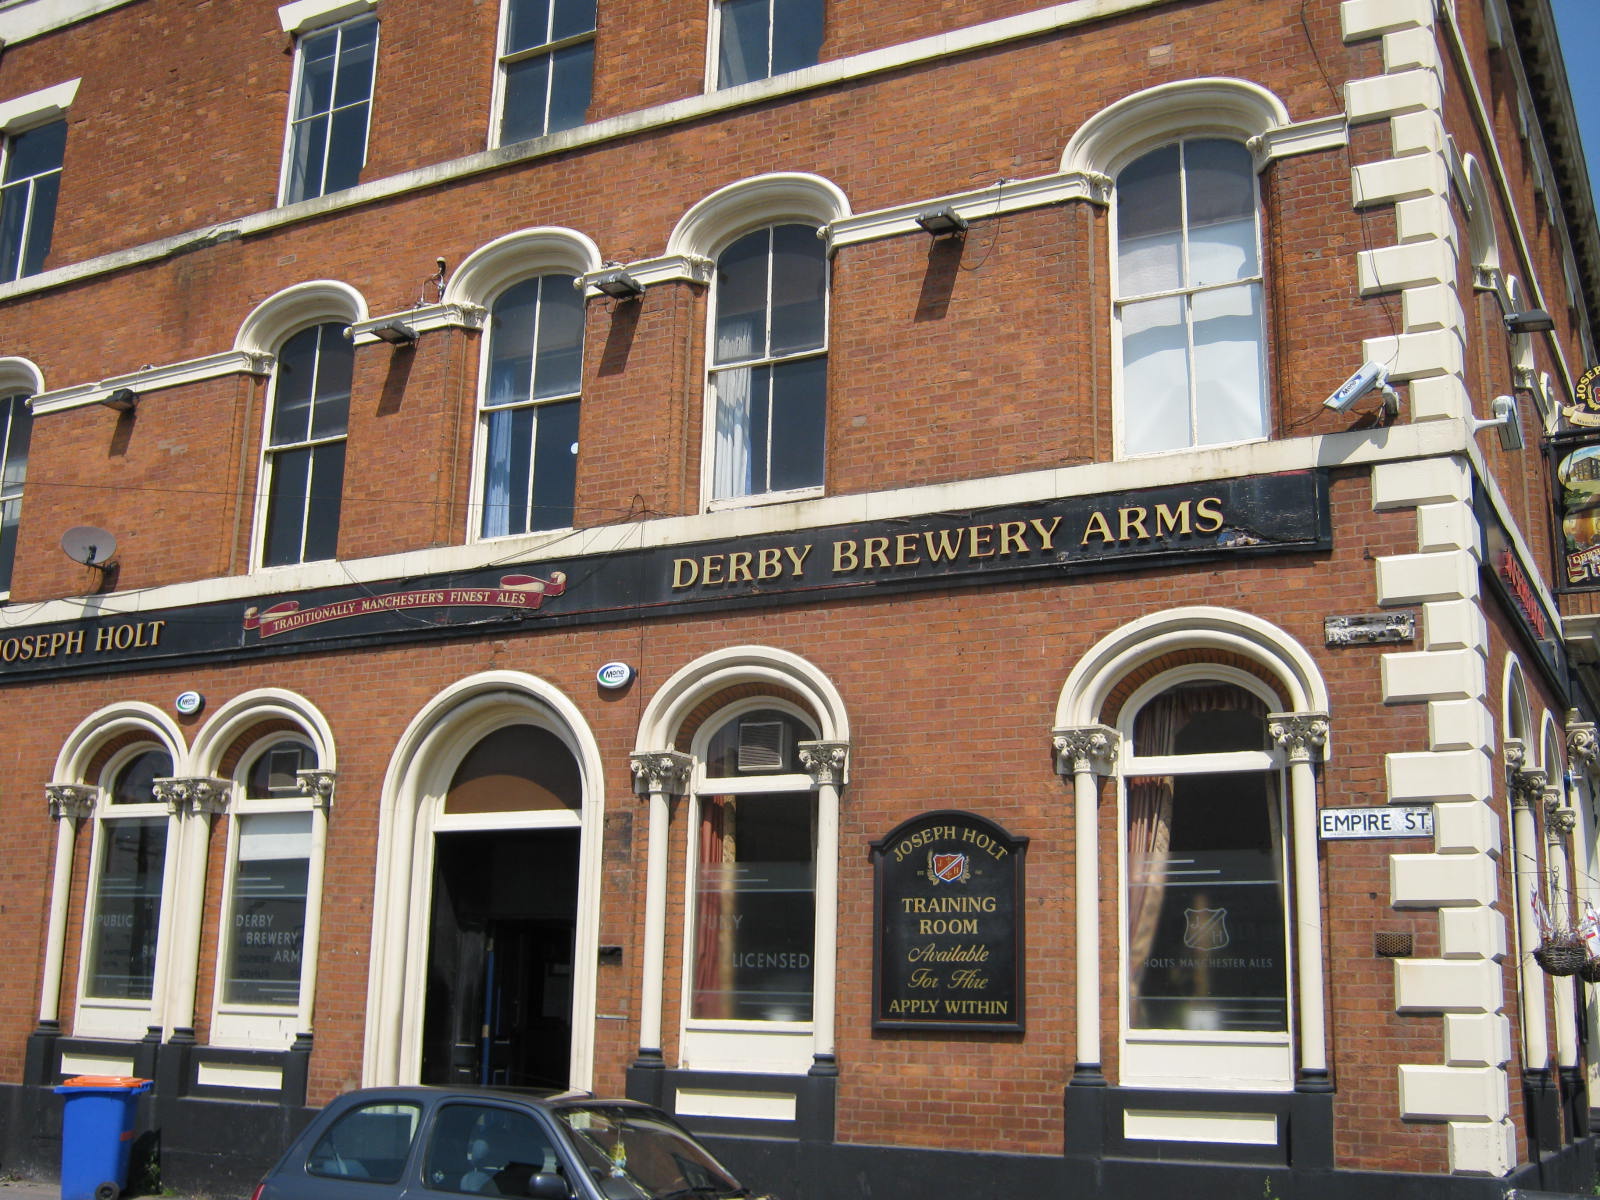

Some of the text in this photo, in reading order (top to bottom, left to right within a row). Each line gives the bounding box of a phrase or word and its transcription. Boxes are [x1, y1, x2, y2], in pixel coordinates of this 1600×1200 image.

[1577, 366, 1600, 399] JOSEP
[672, 497, 1225, 588] DERBY BREWERY ARMS
[273, 591, 526, 631] TRADITIONALLY MANCHESTER'S FINEST ALES
[95, 620, 166, 651] HOLT
[605, 669, 625, 678] Mono
[1323, 814, 1392, 832] EMPIRE
[893, 826, 1008, 863] JOSEPH HOLT
[902, 896, 996, 913] TRAINING
[97, 914, 133, 927] PUBLIC
[236, 914, 274, 927] DERBY
[919, 919, 979, 934] ROOM
[246, 931, 298, 944] BREWERY
[273, 950, 301, 962] ARM
[732, 953, 810, 968] LICENSED
[908, 943, 990, 962] Available
[1143, 958, 1273, 968] HOLTS MANCHESTER ALES
[907, 968, 989, 989] For Hire
[889, 999, 1008, 1015] APPLY WITHIN
